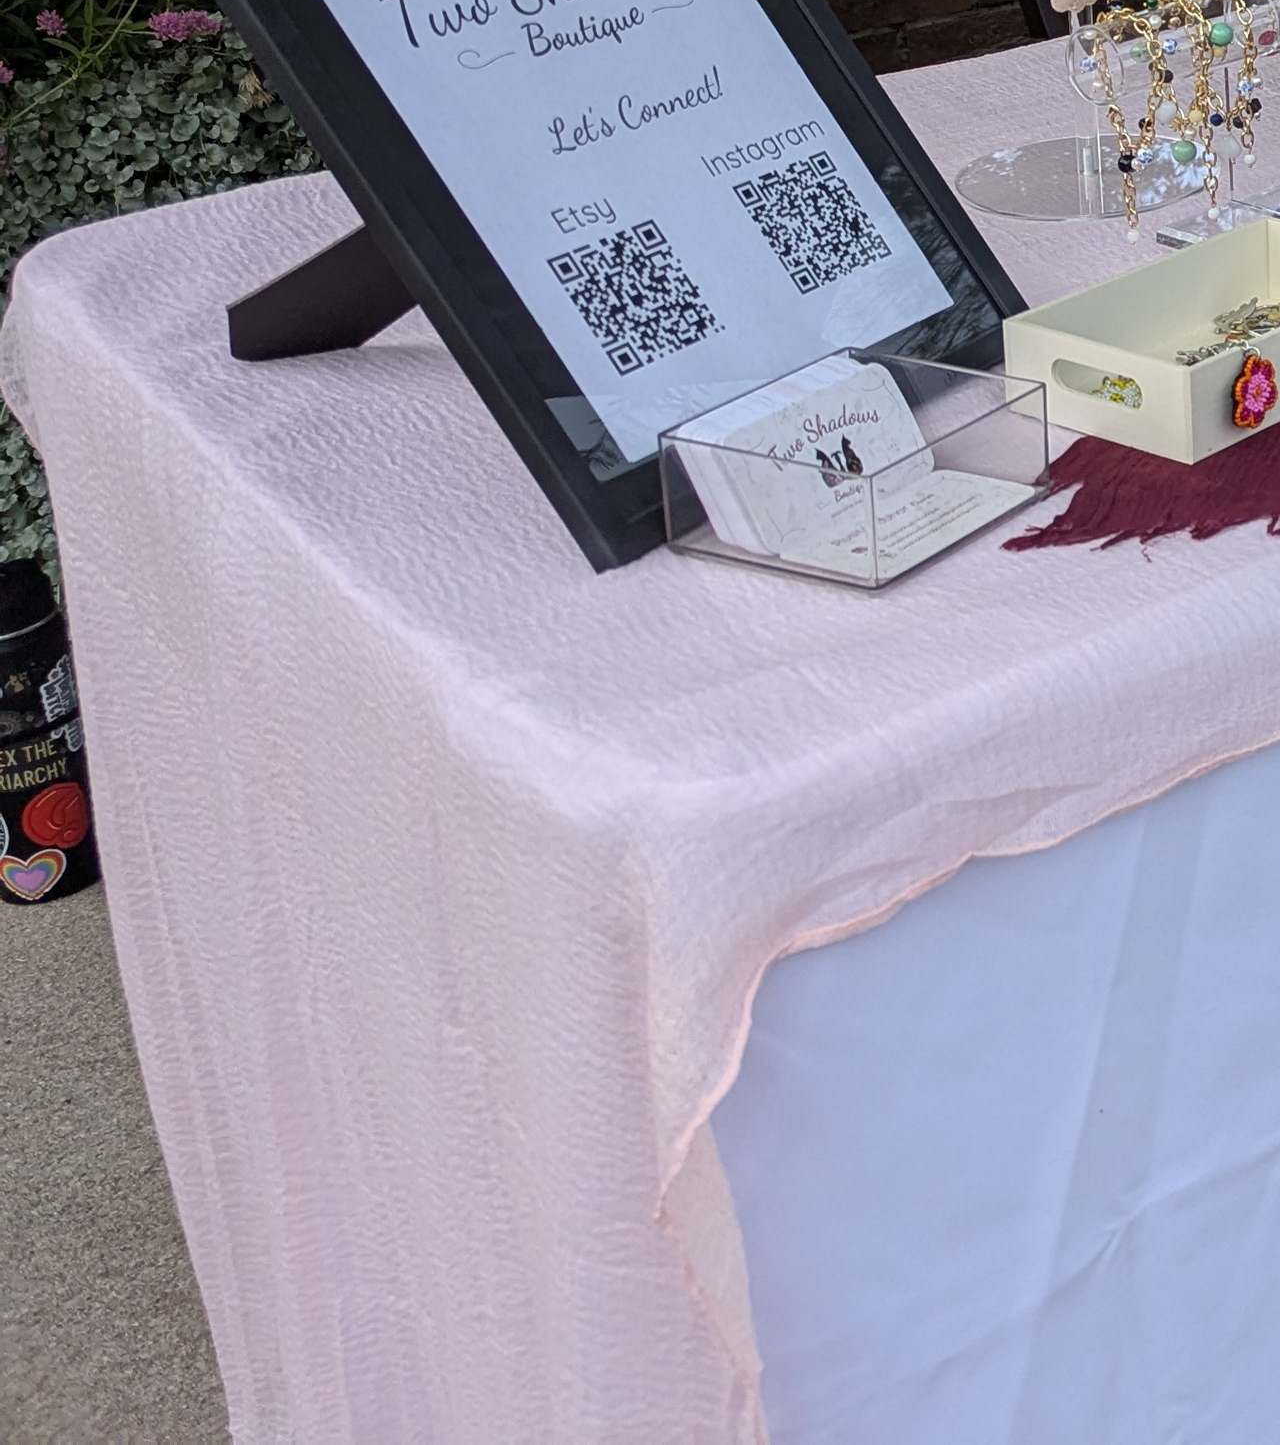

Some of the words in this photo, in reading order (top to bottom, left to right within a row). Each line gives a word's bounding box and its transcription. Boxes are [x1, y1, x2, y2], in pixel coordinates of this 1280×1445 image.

[521, 6, 645, 57] Boutique
[548, 107, 616, 154] Let's
[618, 65, 723, 130] Connect!
[700, 118, 825, 177] Instagram
[550, 197, 617, 234] Etsy
[767, 438, 805, 472] Two
[803, 404, 881, 443] Shadows
[21, 738, 57, 763] THE
